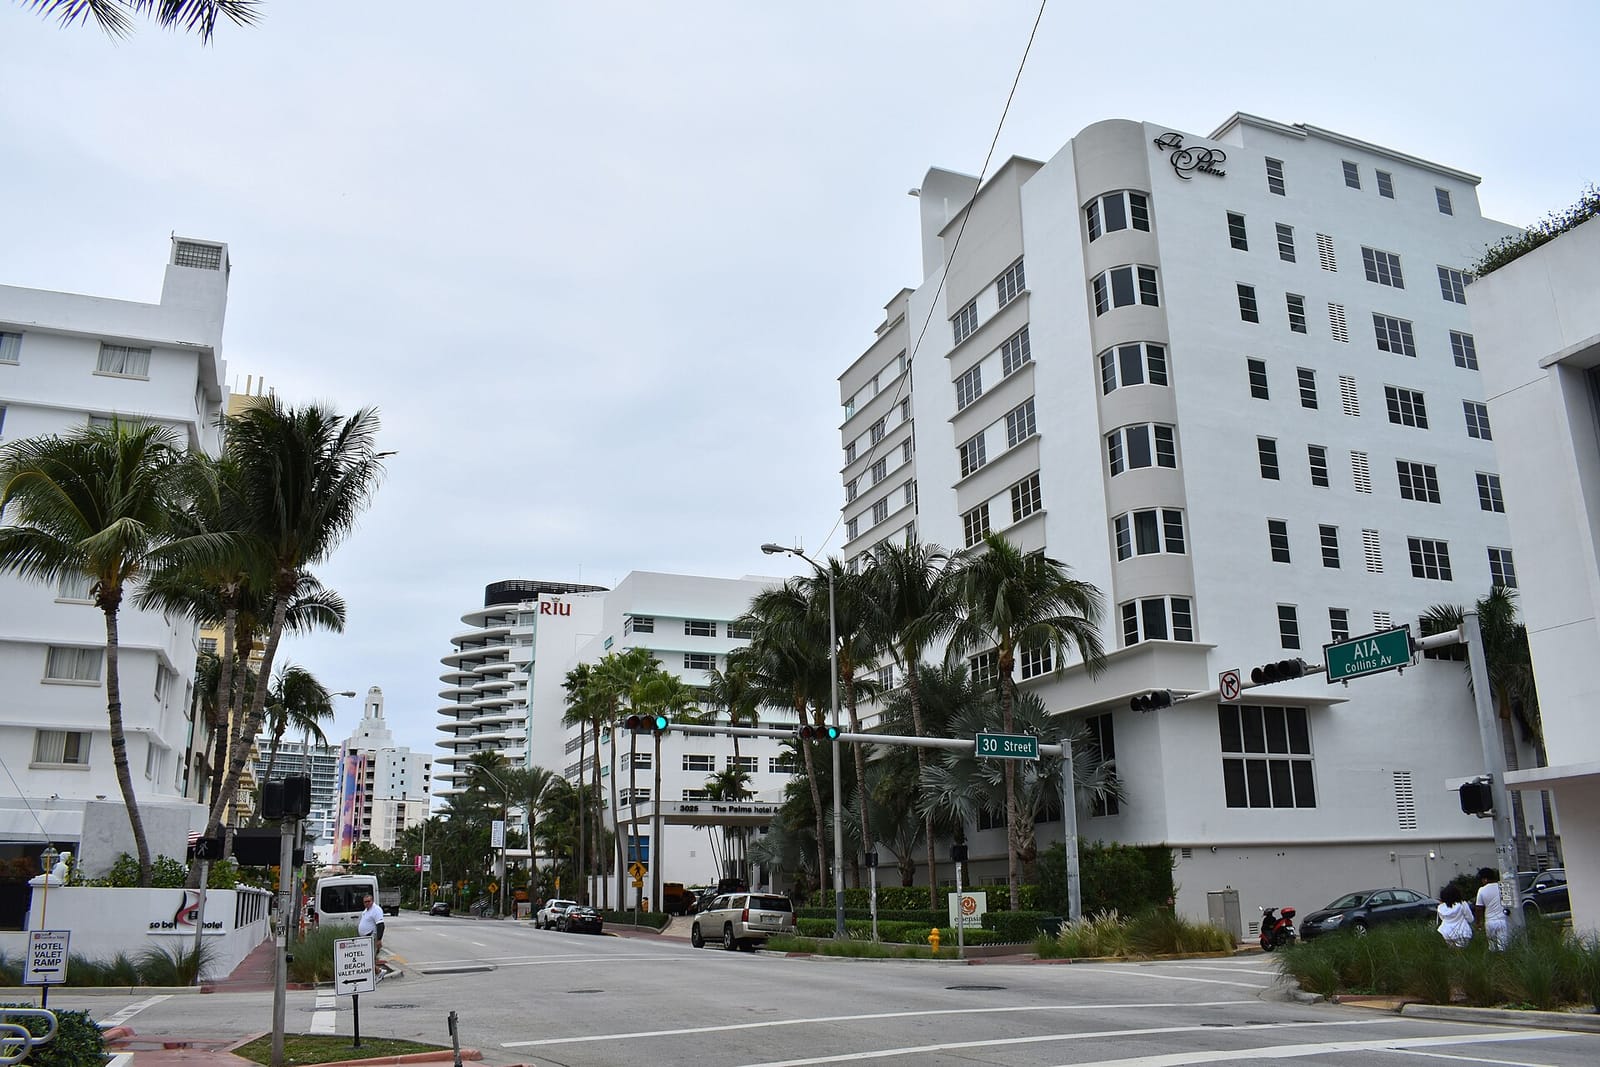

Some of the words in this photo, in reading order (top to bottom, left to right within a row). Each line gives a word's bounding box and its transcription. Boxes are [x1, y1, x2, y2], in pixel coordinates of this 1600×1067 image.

[1170, 146, 1227, 180] Palms
[540, 601, 571, 616] RIU
[1354, 639, 1381, 660] A1A
[1345, 659, 1377, 673] Collins
[1380, 655, 1392, 666] Av
[982, 738, 998, 752] 30
[1003, 740, 1032, 753] Street
[680, 804, 699, 813] 3025
[712, 805, 727, 813] The
[728, 805, 752, 814] Palms
[754, 806, 772, 814] hotel
[202, 921, 223, 929] hotel
[34, 942, 64, 950] HOTEL
[34, 951, 62, 959] VALET
[33, 958, 62, 967] RAMP
[344, 962, 366, 970] BEACH
